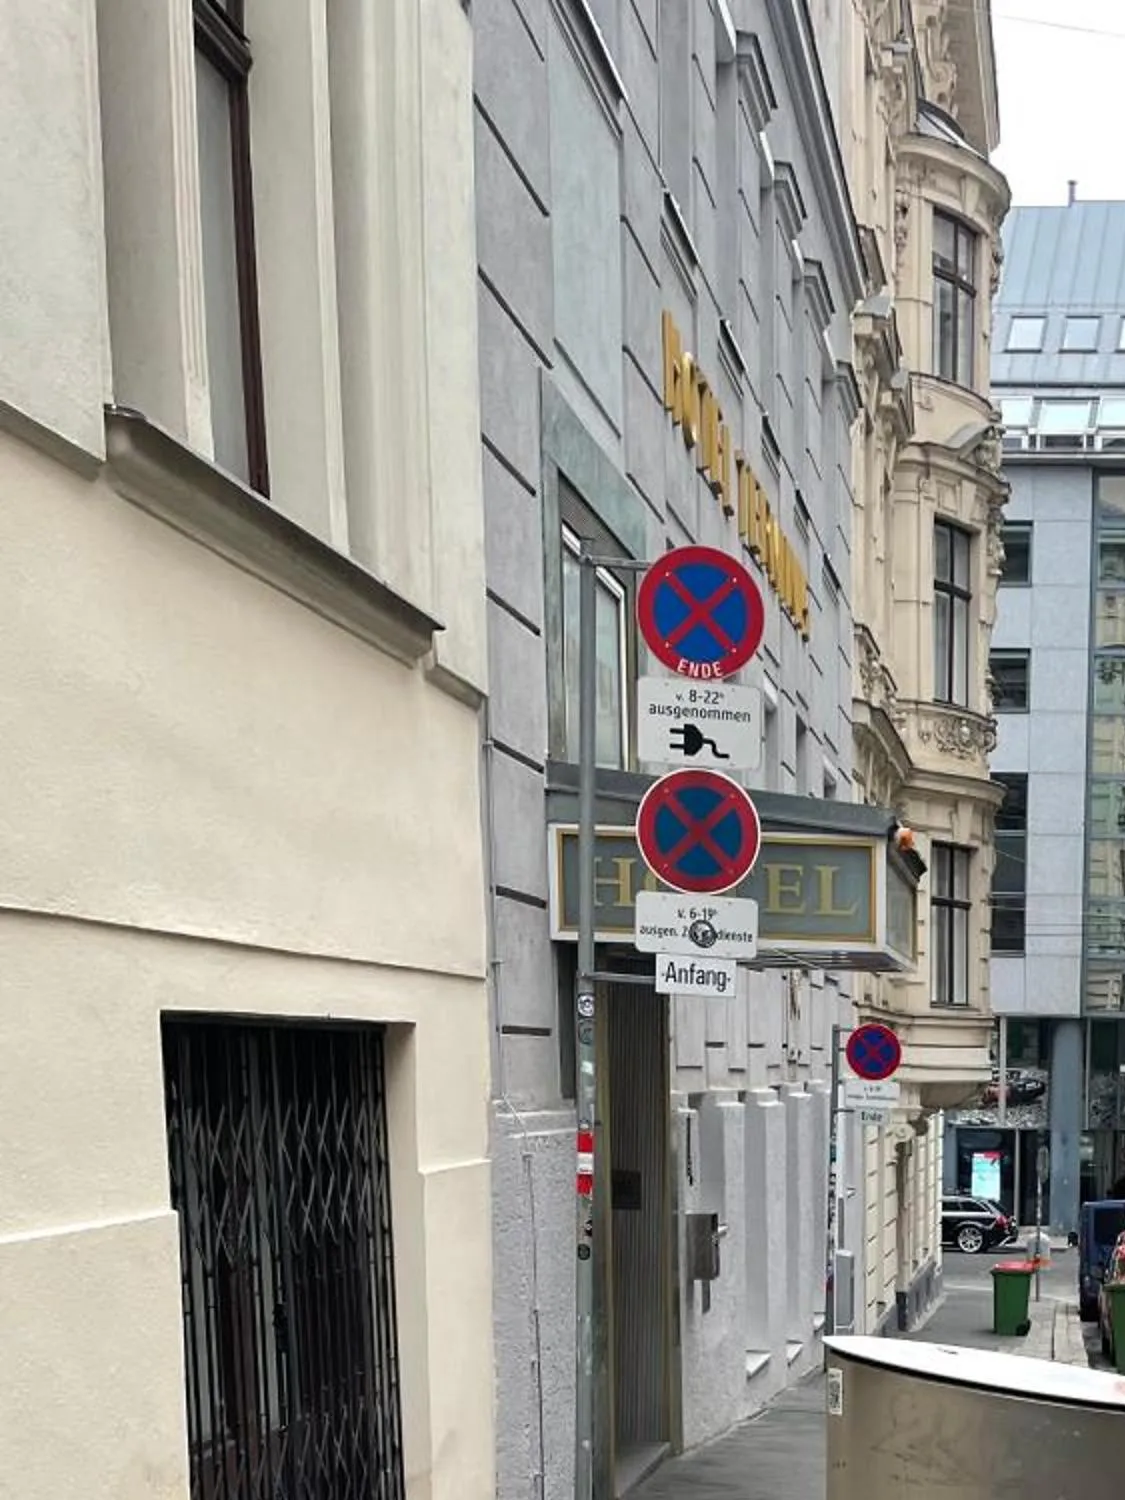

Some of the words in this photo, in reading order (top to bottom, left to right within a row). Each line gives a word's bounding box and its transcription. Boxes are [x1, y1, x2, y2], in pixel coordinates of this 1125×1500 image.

[677, 659, 723, 679] ENDE
[649, 703, 751, 723] ausgenommen
[592, 855, 859, 915] HEL
[664, 961, 728, 993] Anfang
